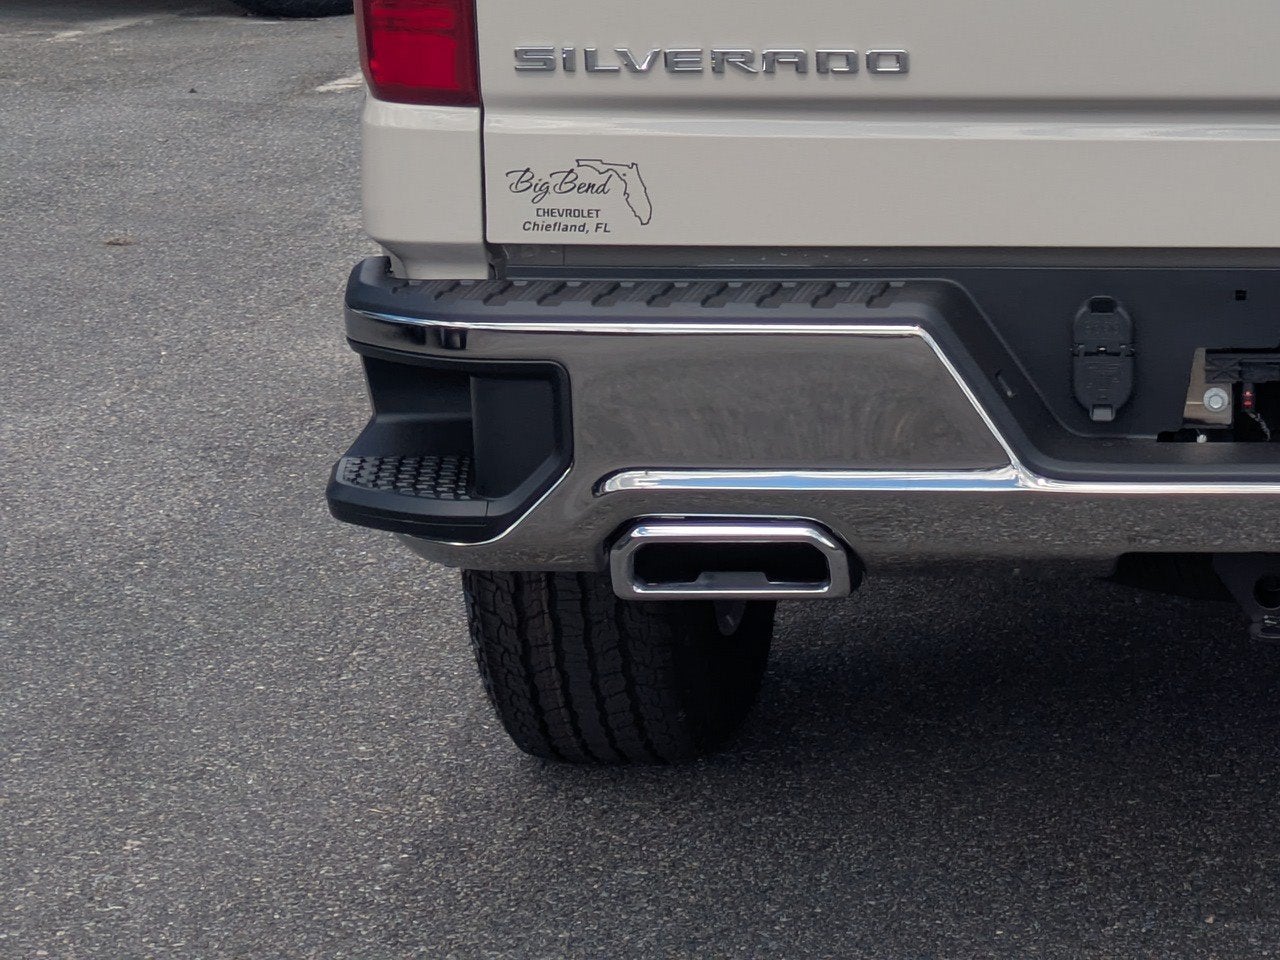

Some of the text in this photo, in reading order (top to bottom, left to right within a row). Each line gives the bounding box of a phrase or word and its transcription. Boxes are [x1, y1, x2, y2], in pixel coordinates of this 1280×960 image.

[514, 46, 910, 75] SILVERADO
[506, 167, 612, 204] Big Bend
[536, 207, 601, 219] CHEVROLET
[522, 220, 611, 234] Chiefland, FL
